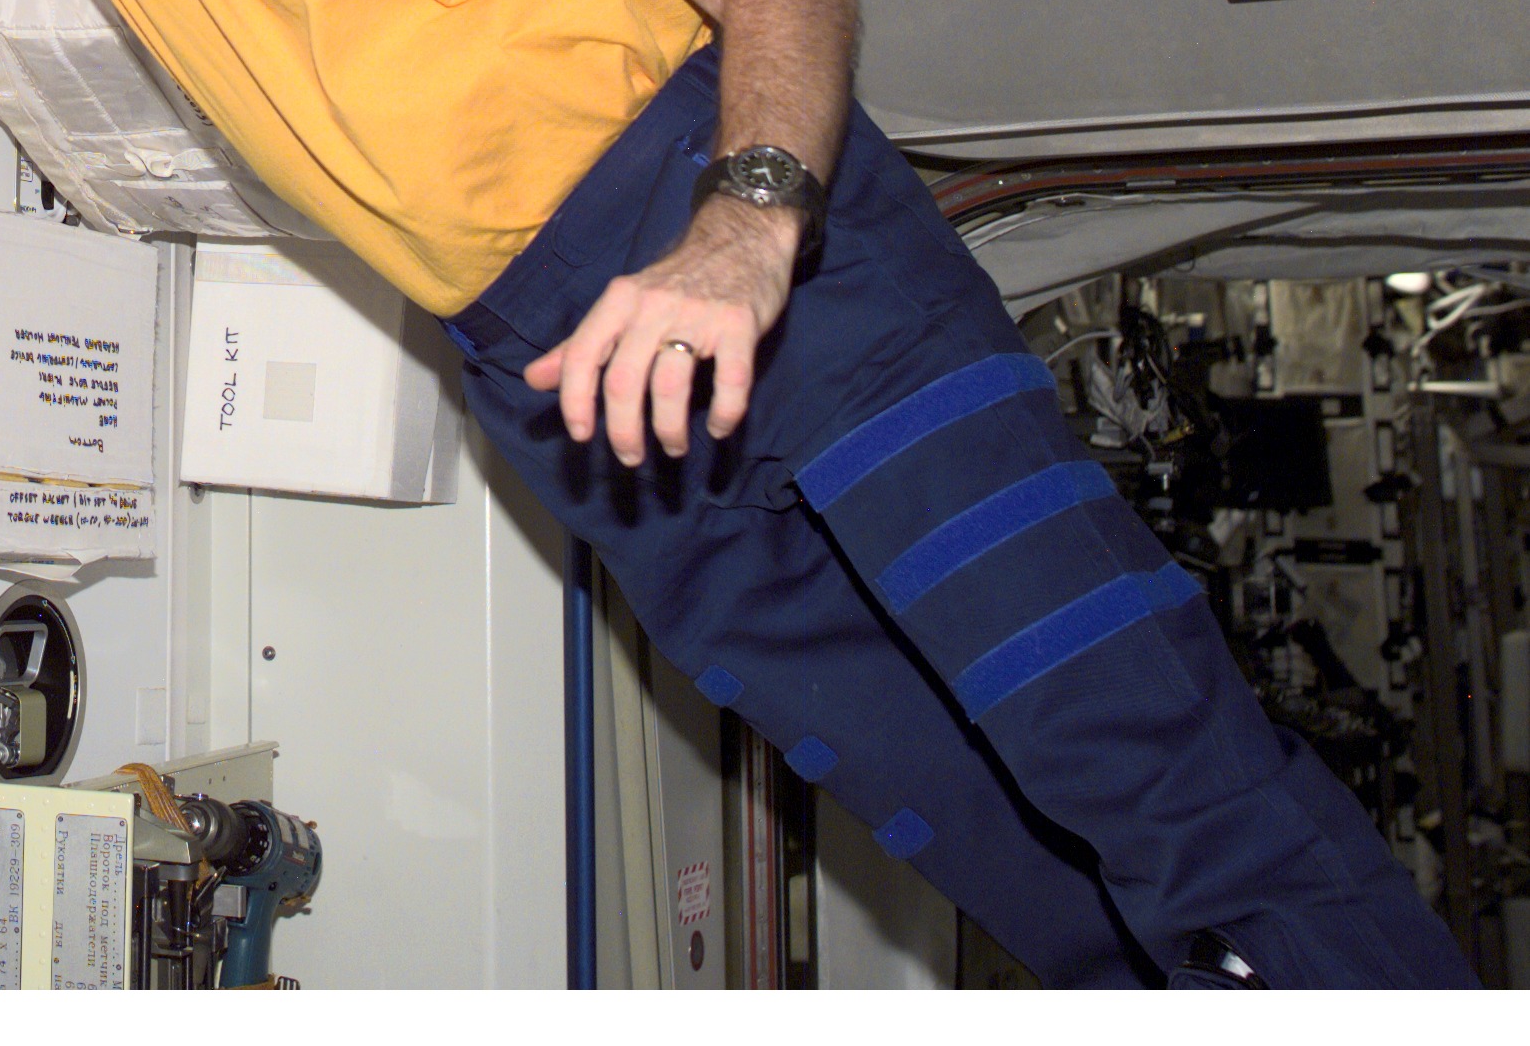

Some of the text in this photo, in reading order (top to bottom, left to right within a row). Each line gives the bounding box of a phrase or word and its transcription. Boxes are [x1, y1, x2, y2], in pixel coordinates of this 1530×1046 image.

[219, 326, 239, 431] TOOL KIT
[9, 822, 21, 897] 19229-309
[55, 830, 69, 896] Рукоятки
[87, 832, 102, 969] Плашкодержатели
[54, 920, 64, 949] для
[99, 833, 114, 989] Вороток под метчик
